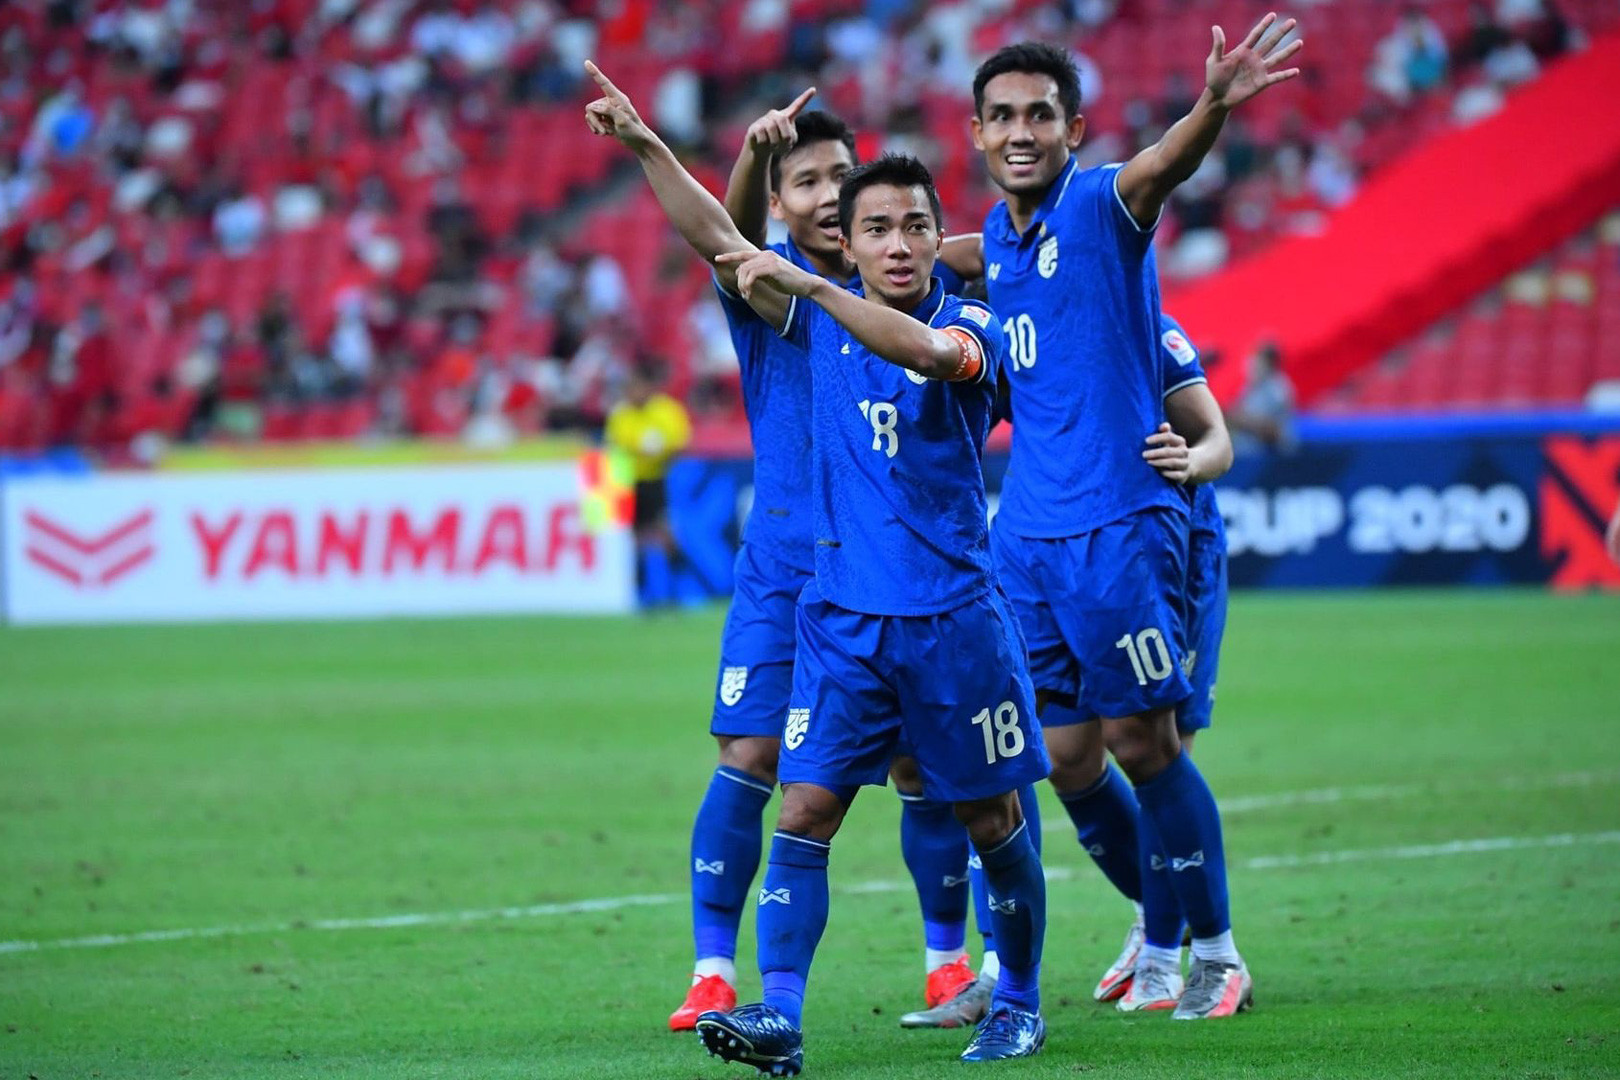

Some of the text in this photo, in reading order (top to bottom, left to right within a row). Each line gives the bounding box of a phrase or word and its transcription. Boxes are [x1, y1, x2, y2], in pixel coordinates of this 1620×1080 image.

[1003, 313, 1037, 372] 10
[190, 504, 598, 578] YANMAR
[1349, 485, 1530, 554] 2020
[1115, 627, 1173, 686] 10
[971, 700, 1025, 765] 18
